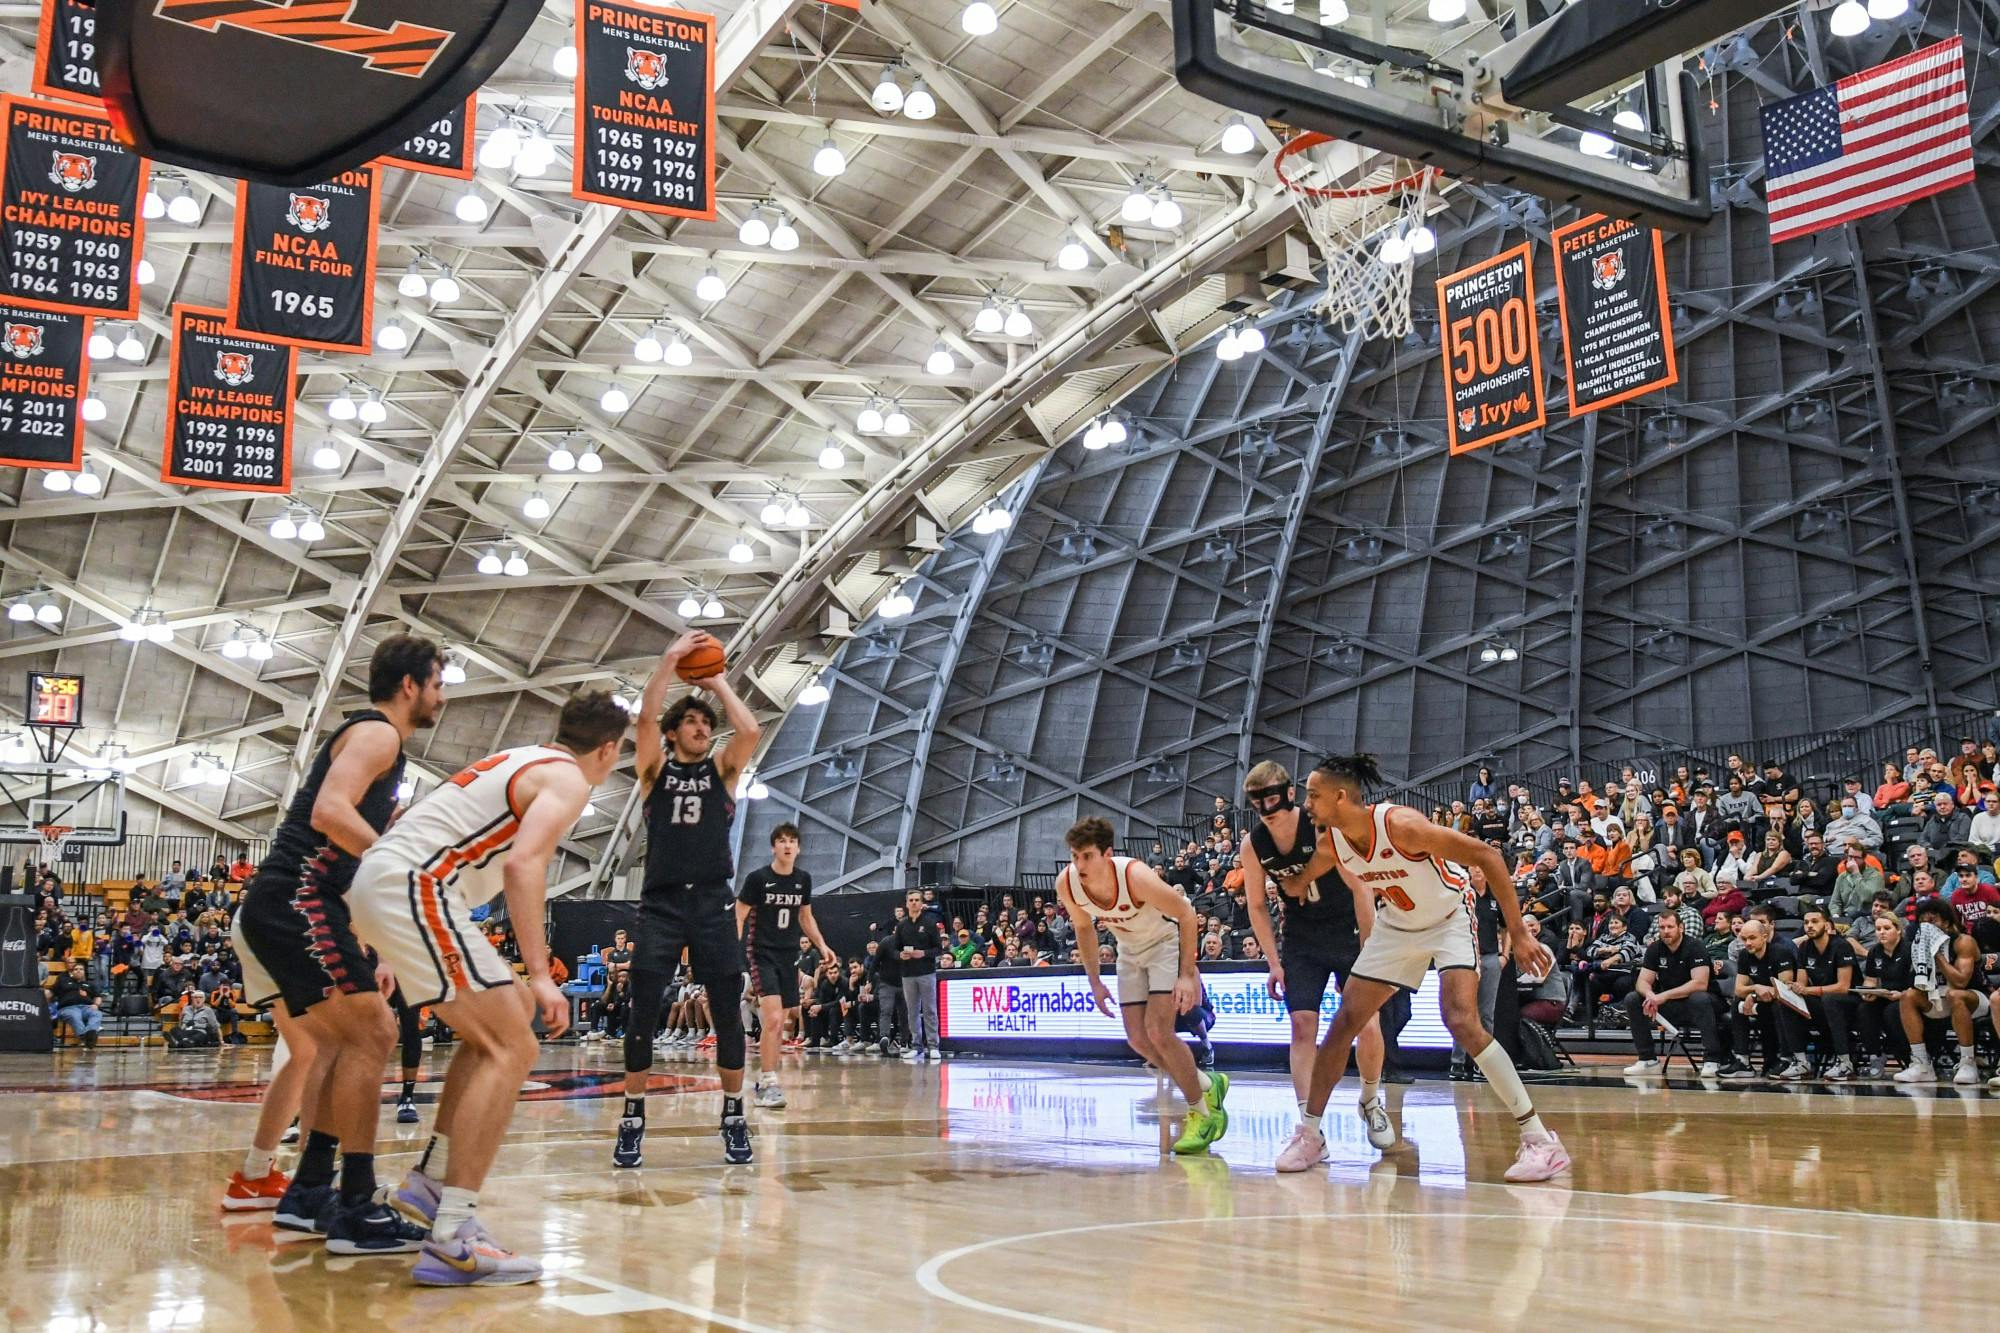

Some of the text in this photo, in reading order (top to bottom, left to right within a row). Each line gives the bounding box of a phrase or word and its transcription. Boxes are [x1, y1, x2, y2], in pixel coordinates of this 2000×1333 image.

[588, 4, 704, 43] PRINCETON
[602, 26, 692, 52] MEN'S BASKETBALL
[619, 90, 673, 115] NCAA
[592, 105, 698, 136] TOURNAMENT
[27, 131, 125, 154] MEN'S BASKETBALL
[598, 127, 696, 159] 1965 1967
[598, 149, 696, 180] 1969 1976
[597, 171, 694, 202] 1977 1981
[20, 190, 120, 218] IVY LEAGUE
[4, 205, 132, 238] CHAMPIONS
[14, 230, 120, 259] 1959 1960
[273, 232, 338, 260] NCAA
[1563, 230, 1596, 253] PETE
[1571, 228, 1640, 261] MEN'S BASKETBALL
[12, 251, 120, 280] 1961 1963
[255, 250, 353, 277] FINAL FOUR
[10, 272, 118, 301] 1964 1965
[1446, 259, 1523, 304] PRINCETON
[271, 289, 334, 319] 1965
[1461, 282, 1511, 310] ATHLETICS
[1608, 290, 1628, 303] WINS
[12, 309, 69, 322] BASKETBALL
[1584, 311, 1643, 339] CHAMPIONSHIPS
[1587, 299, 1638, 325] 13 IVY LEAGUE
[195, 335, 276, 352] MEN'S BASKETBALL
[1452, 297, 1528, 385] 500
[1575, 332, 1660, 368] 11 NCAA TOURNAMENTS
[1581, 321, 1650, 353] 1975 NIT CHAMPION
[4, 362, 64, 379] LEAGUE
[1577, 356, 1661, 391] NAISMITH BASKETBALL
[1591, 351, 1645, 377] 1997 INDUCTEE
[1, 376, 76, 399] MPIONS
[191, 387, 273, 406] IVY LEAGUE
[1456, 366, 1530, 401] CHAMPIONSHIPS
[1593, 371, 1646, 396] HALL OF FAME
[22, 400, 65, 418] 2011
[178, 400, 284, 424] CHAMPIONS
[1480, 399, 1512, 426] Ivy
[20, 419, 65, 437] 2022
[186, 420, 276, 443] 1992 1996
[185, 439, 275, 461] 1997 1998
[183, 457, 274, 479] 2001 2002
[664, 775, 711, 792] PENN
[671, 796, 702, 825] 13
[765, 892, 803, 905] PENN
[777, 908, 791, 929] 0
[987, 1015, 1037, 1031] HEALTH
